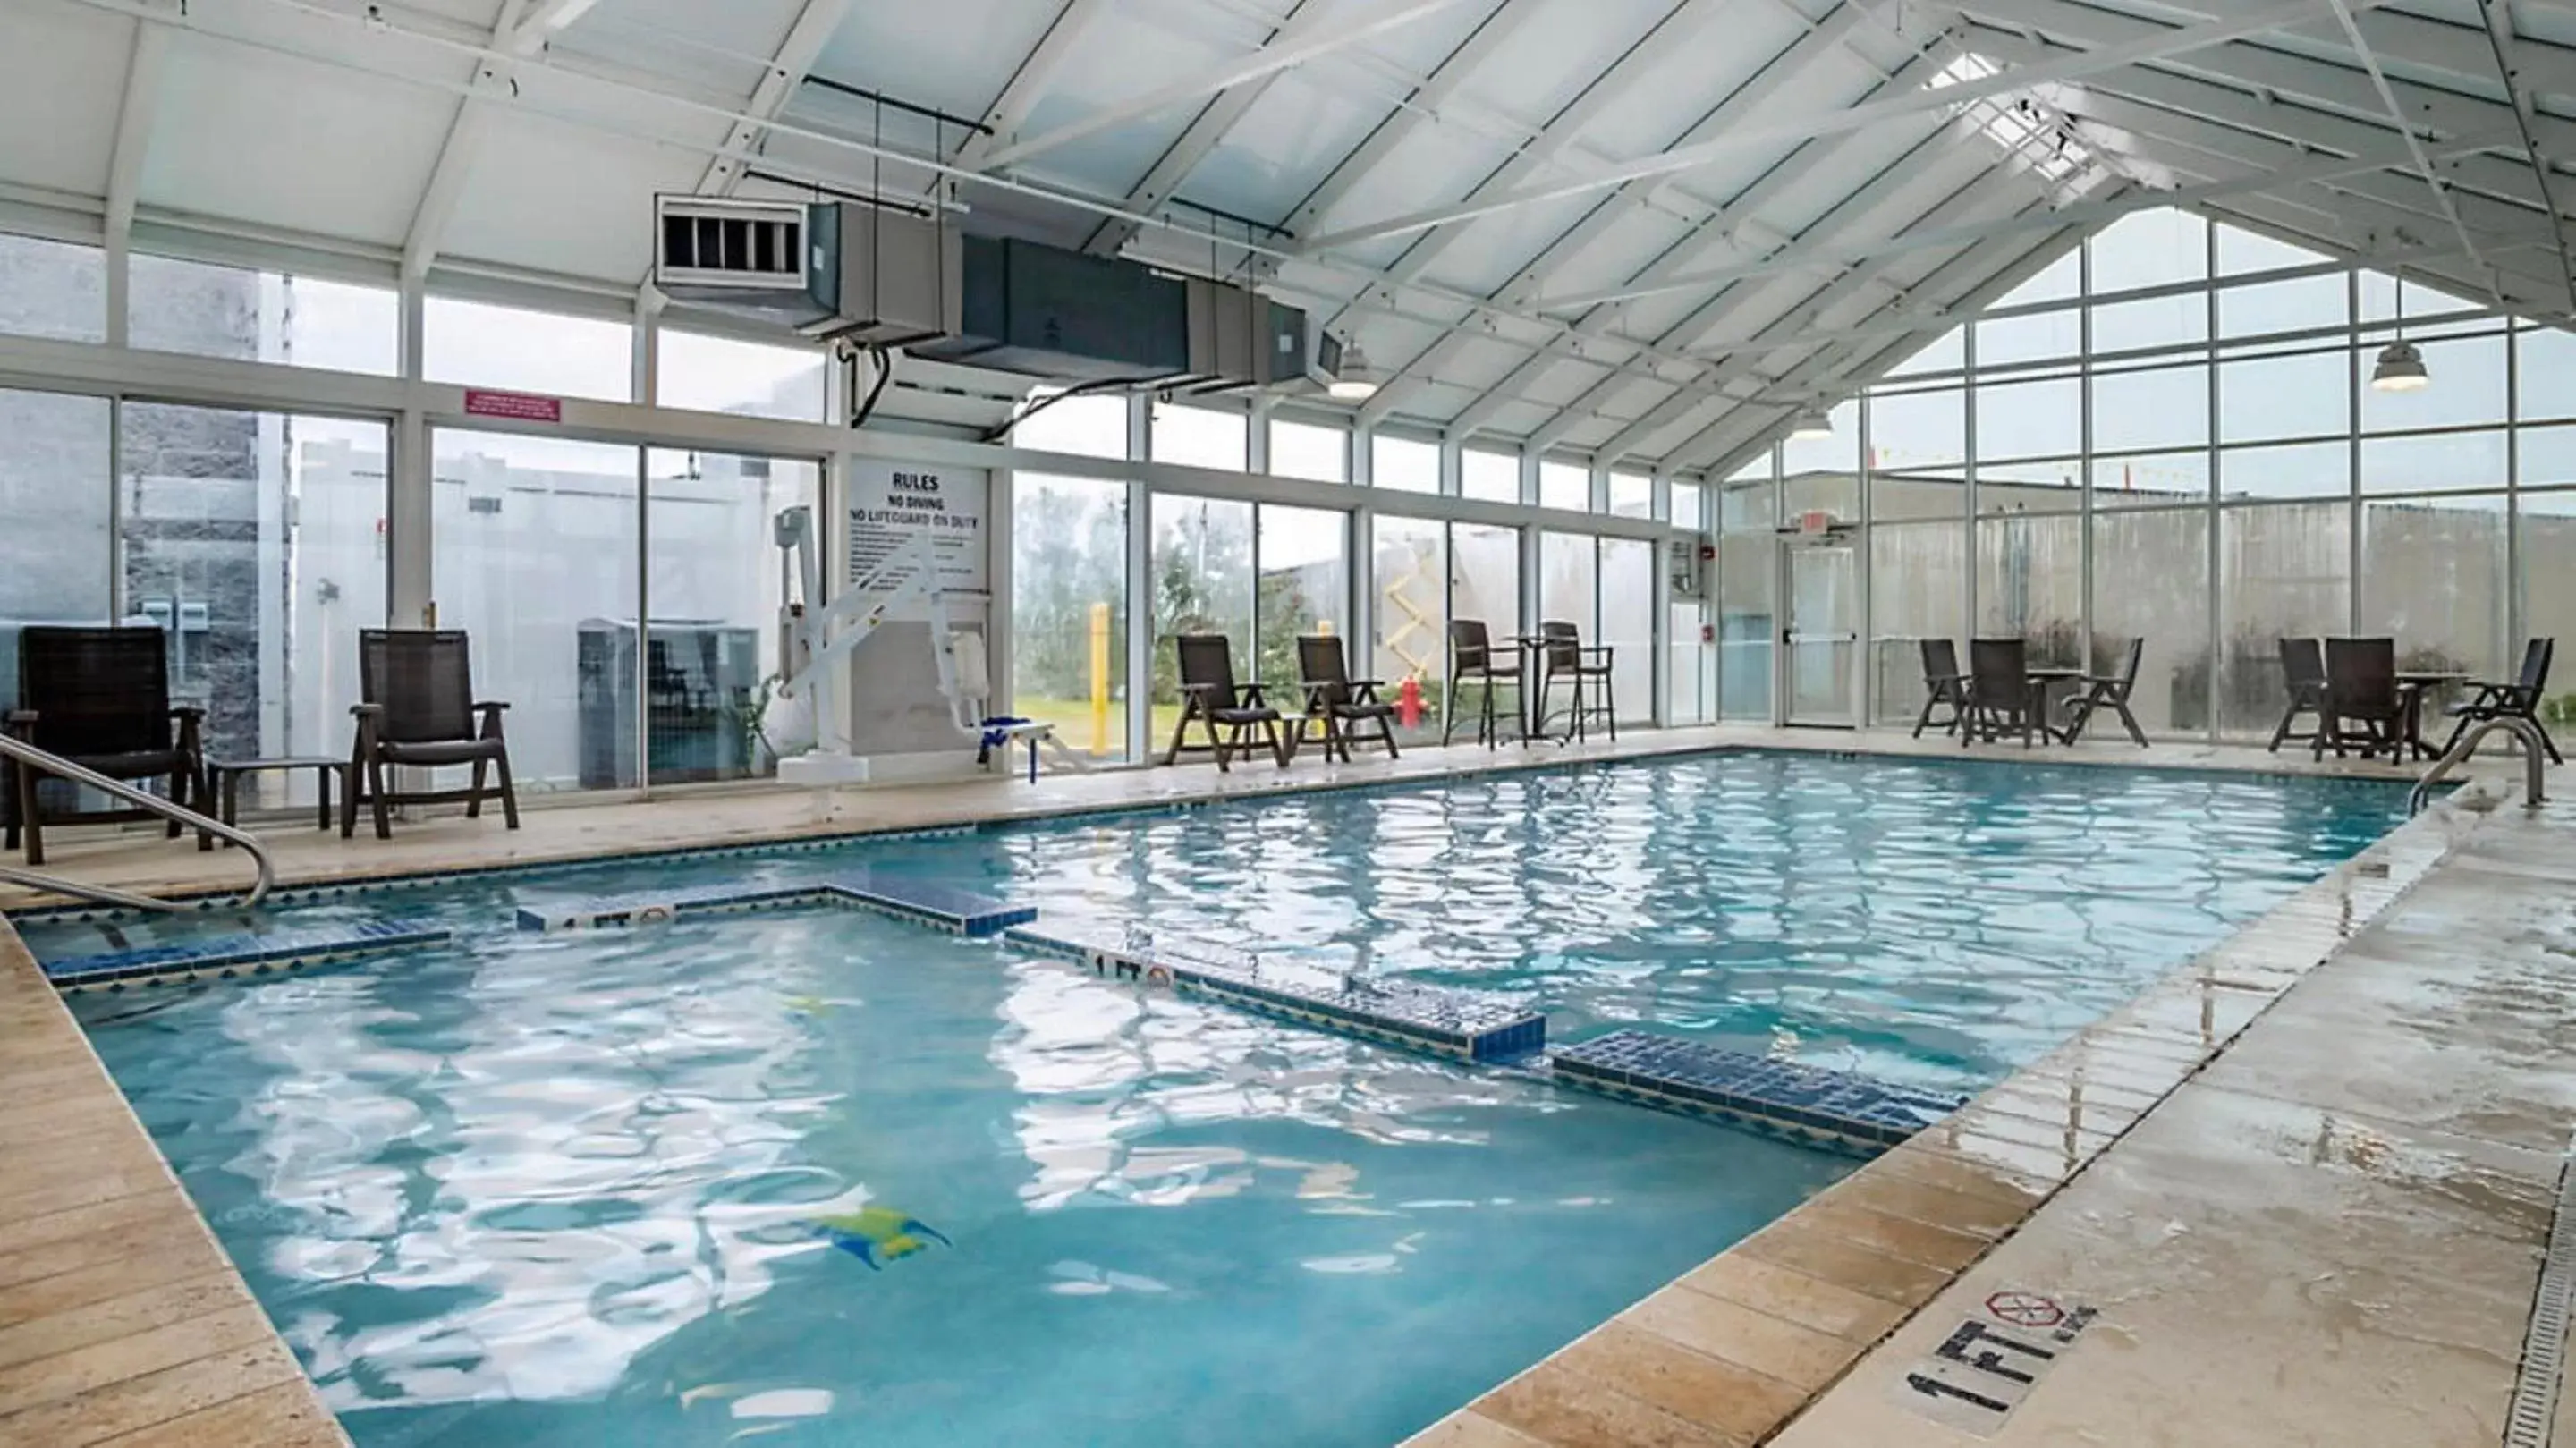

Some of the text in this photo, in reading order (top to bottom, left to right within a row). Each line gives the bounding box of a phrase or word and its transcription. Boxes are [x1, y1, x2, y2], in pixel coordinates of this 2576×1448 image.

[894, 472, 939, 491] RULES
[887, 495, 945, 511] NO DIVING
[850, 509, 978, 529] NO LIFEGUARD ON DUTY
